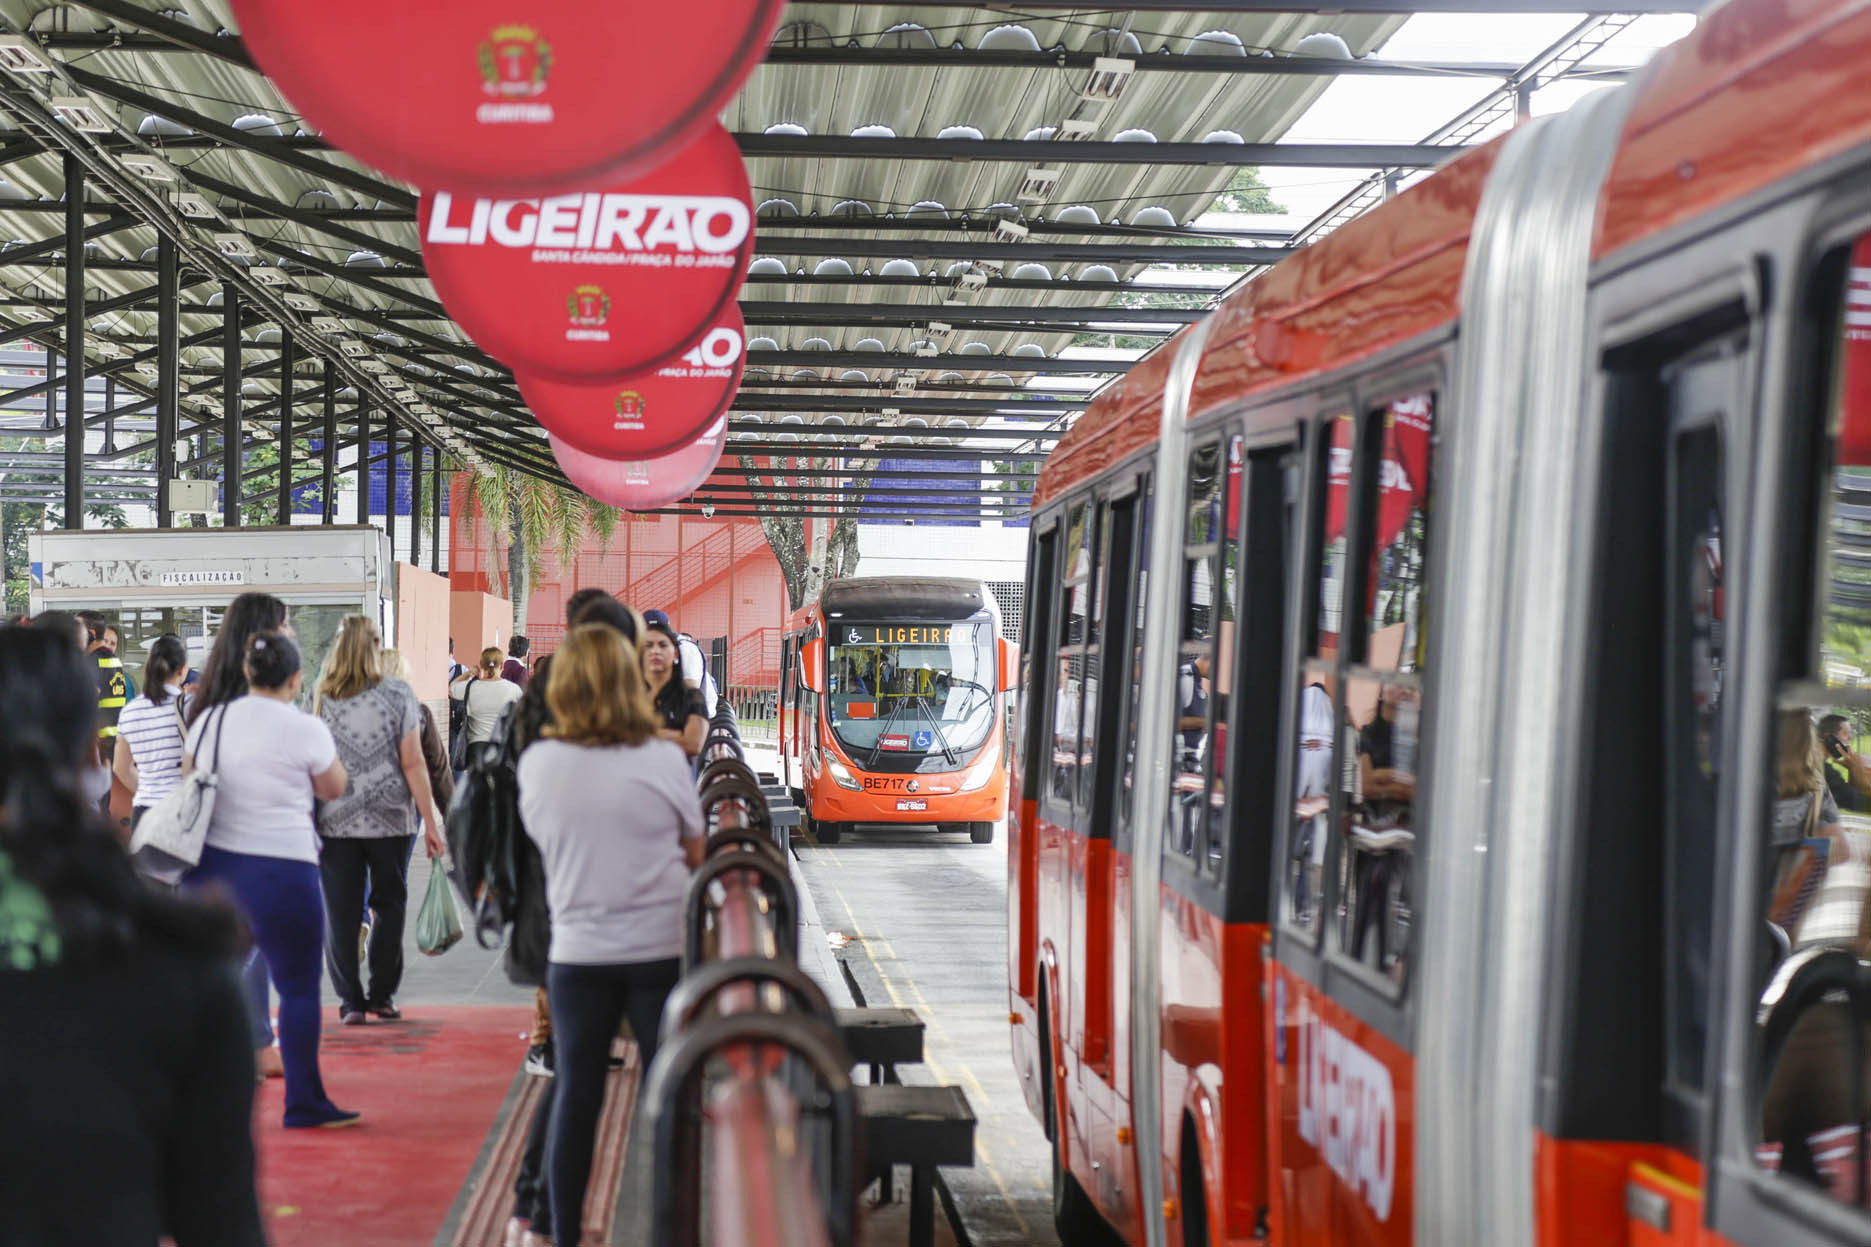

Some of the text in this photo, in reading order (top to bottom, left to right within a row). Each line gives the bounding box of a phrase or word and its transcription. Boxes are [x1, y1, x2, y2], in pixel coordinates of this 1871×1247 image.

[531, 249, 571, 262] SANTA
[675, 255, 695, 267] DO
[864, 777, 904, 790] BE717
